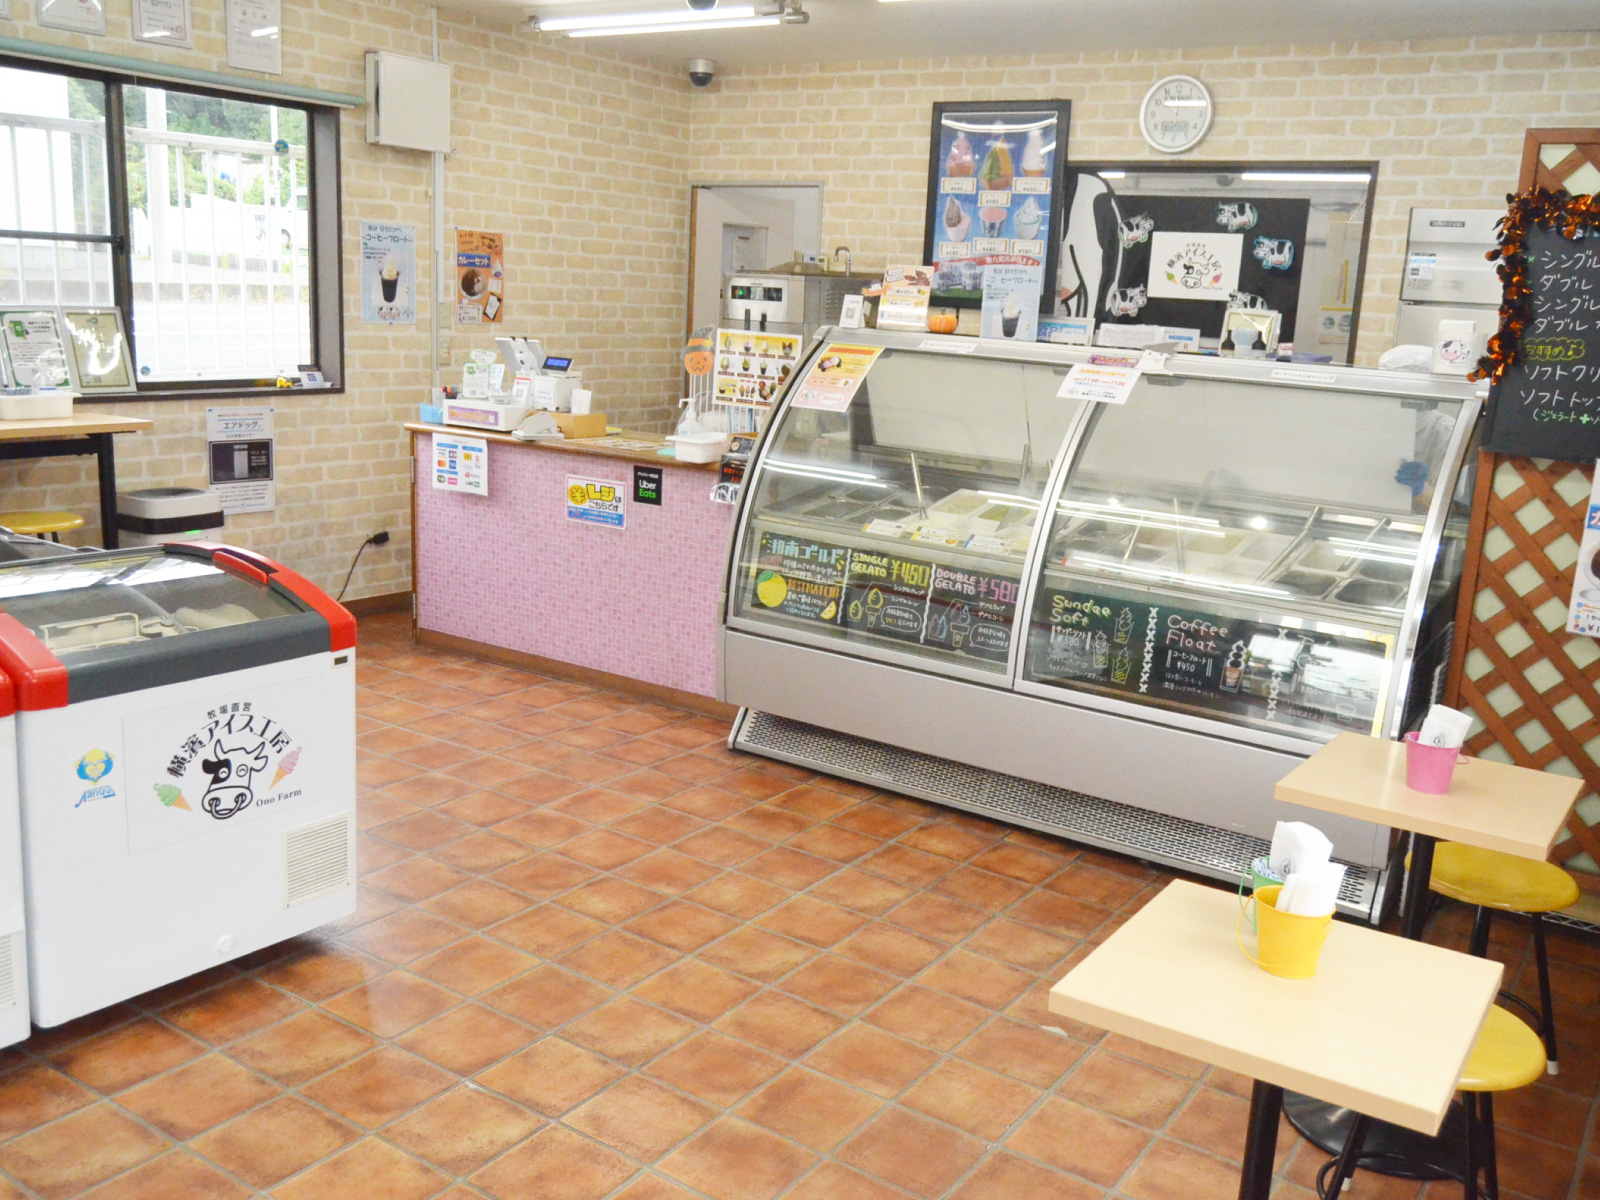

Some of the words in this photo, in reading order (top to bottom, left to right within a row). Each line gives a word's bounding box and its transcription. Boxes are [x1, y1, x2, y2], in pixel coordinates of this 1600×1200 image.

[458, 256, 490, 266] カレーセット
[1540, 250, 1600, 270] シングル
[1540, 273, 1593, 292] ダブル
[1534, 295, 1600, 315] シングル
[1535, 315, 1589, 334] ダブル
[1520, 389, 1600, 411] ソフトトッ
[223, 421, 258, 430] エアドッグ
[639, 480, 657, 490] Uber
[639, 488, 656, 498] Eats
[588, 500, 620, 512] こちらです
[772, 539, 845, 564] 湘南ゴールド
[852, 552, 889, 567] SINGLE
[851, 562, 887, 578] GELATO
[936, 568, 977, 585] DOUBLE
[934, 578, 976, 595] GELATO
[1052, 595, 1112, 619] Sundae
[1049, 607, 1090, 628] Soft
[1167, 614, 1228, 637] Coffee
[1056, 625, 1087, 639] サンデーソフト
[1165, 629, 1216, 651] Float
[1057, 635, 1080, 647] ¥580
[1172, 651, 1207, 665] コーヒーフロート
[1177, 660, 1195, 672] ¥450
[207, 702, 252, 720] 牧場直営
[166, 713, 293, 779] 横濱アイス工房
[256, 797, 275, 808] Ono
[277, 788, 303, 802] Farm
